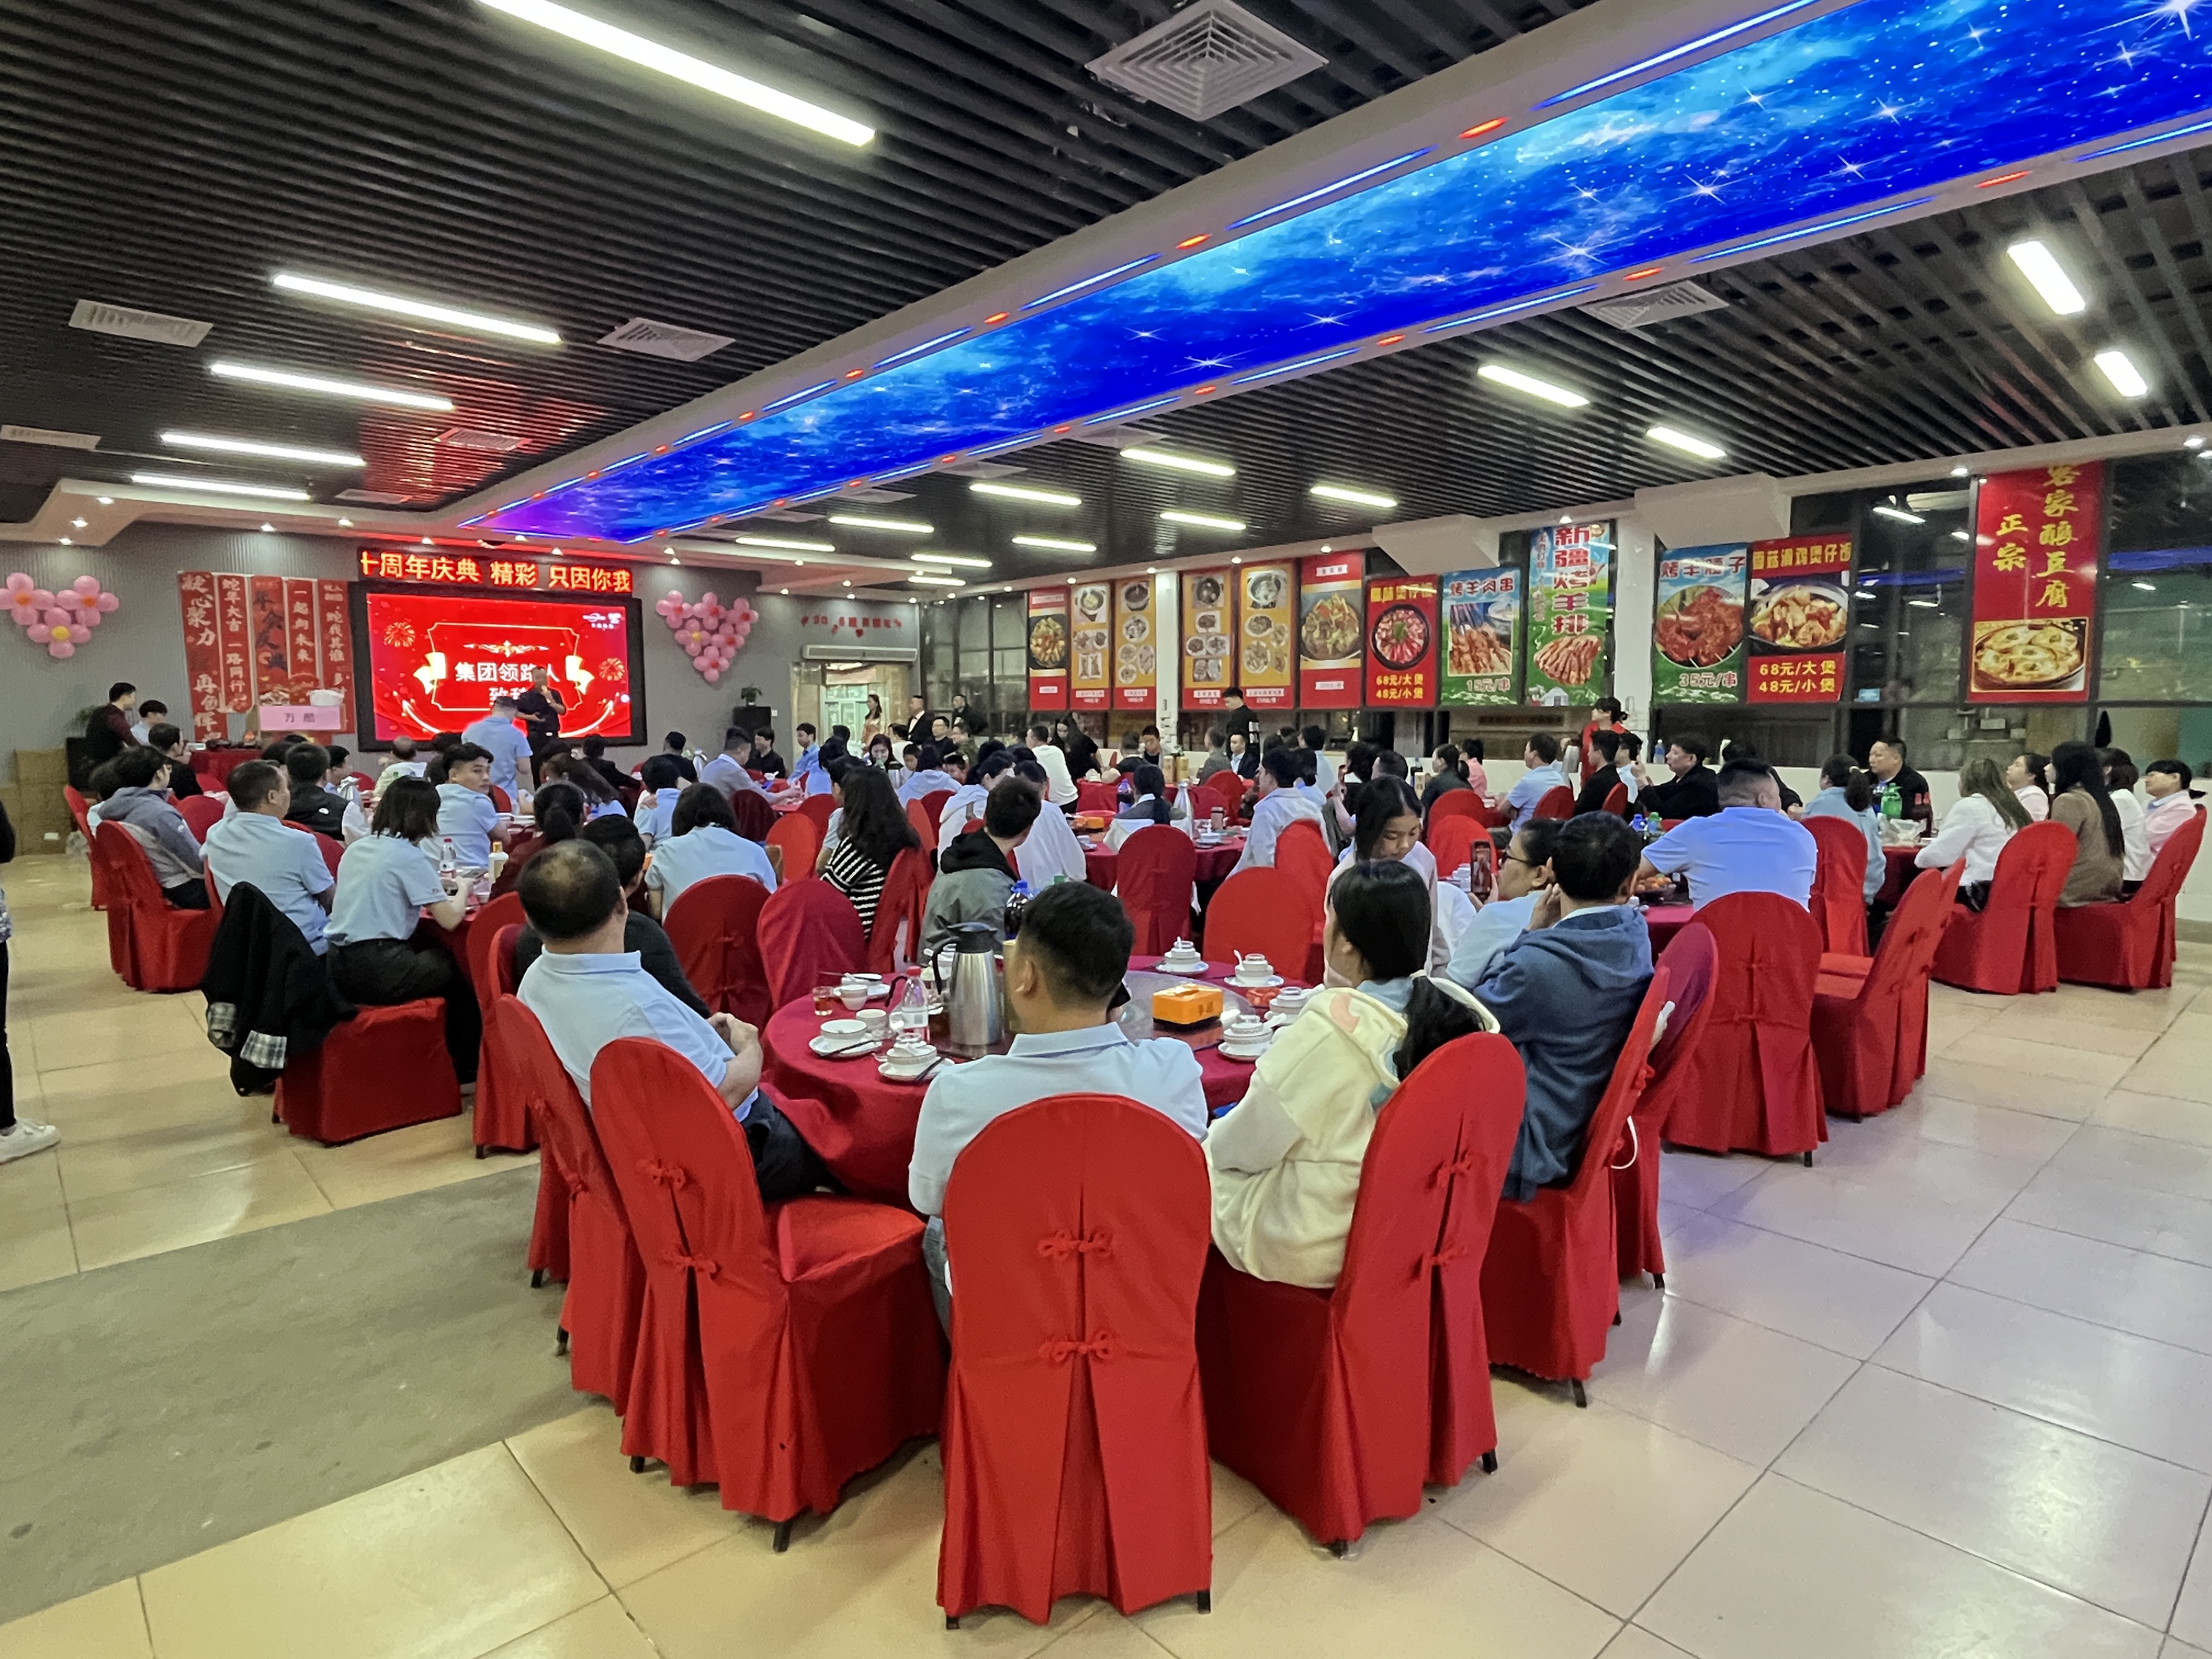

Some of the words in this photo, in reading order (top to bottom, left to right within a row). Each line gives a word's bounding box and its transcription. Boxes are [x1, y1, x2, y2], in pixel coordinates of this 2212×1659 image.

[1993, 514, 2029, 572] 正宗
[489, 560, 538, 586] 精彩
[548, 565, 633, 593] 只因你我
[1449, 577, 1514, 597] 烤羊肉串
[1553, 526, 1590, 635] 新疆烤羊排
[1466, 677, 1511, 692] 15元/串
[1678, 670, 1738, 688] 35元/串
